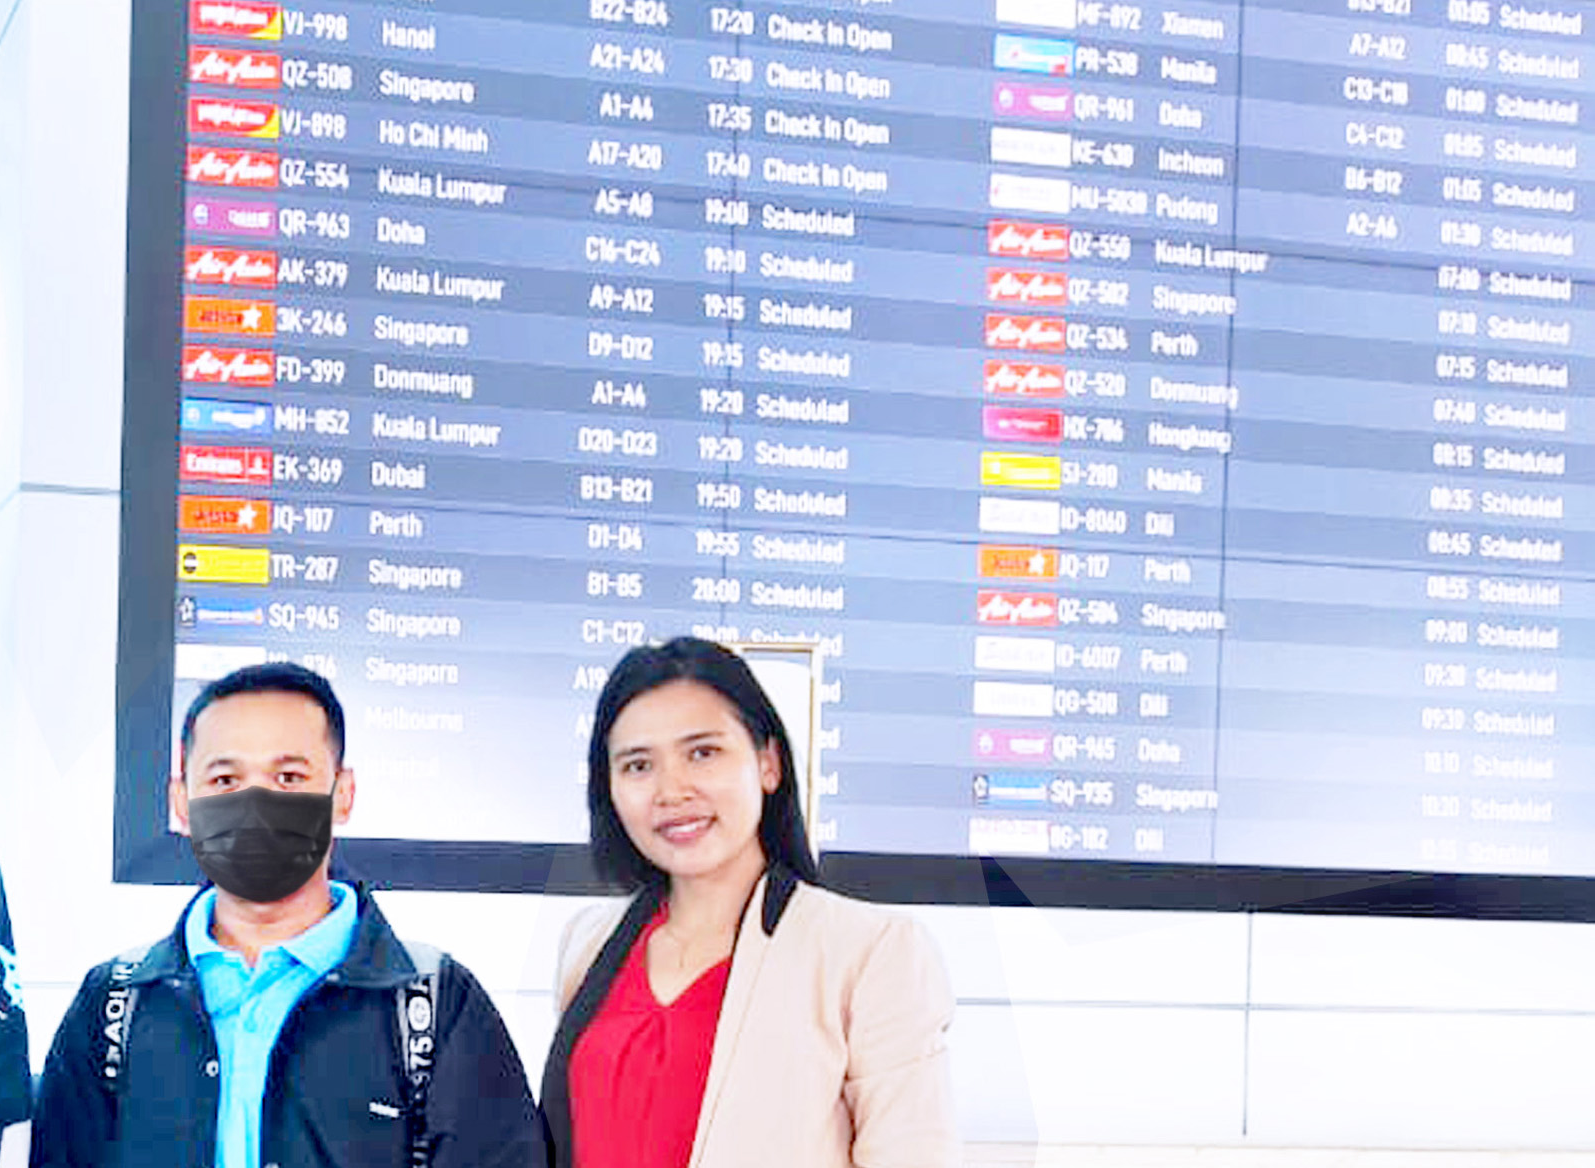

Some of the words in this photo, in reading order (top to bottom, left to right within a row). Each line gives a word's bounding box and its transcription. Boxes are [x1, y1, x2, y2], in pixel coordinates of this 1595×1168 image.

[284, 12, 347, 40] VJ-998
[382, 20, 435, 49] Hanoi
[590, 44, 665, 74] A21-A24
[709, 56, 753, 83] 17:30
[767, 62, 822, 90] Check
[826, 70, 842, 92] In
[846, 71, 890, 98] Open
[711, 9, 754, 35] 17:20
[768, 15, 823, 43] Check
[828, 22, 844, 45] In
[847, 24, 892, 51] Open
[1161, 56, 1217, 84] Manila
[379, 70, 474, 102] Singapore
[600, 93, 653, 120] A1-A4
[708, 104, 752, 131] 17:35
[765, 110, 820, 138] Check
[825, 117, 841, 139] In
[844, 119, 889, 146] Open
[380, 120, 405, 144] Ho
[409, 122, 439, 147] Chi
[443, 125, 488, 152] Minh
[589, 141, 662, 171] A17-A20
[764, 158, 819, 185] Check
[822, 165, 839, 188] In
[842, 166, 887, 191] Open
[280, 160, 348, 189] QZ-554
[379, 169, 431, 196] Kuala
[436, 175, 506, 205] Lumpur
[763, 205, 854, 236] Scheduled
[1156, 193, 1218, 224] Pudong
[279, 209, 350, 237] QR-963
[377, 218, 425, 245] Doha
[761, 252, 853, 283] Scheduled
[1156, 240, 1202, 266] Kuala
[1205, 245, 1269, 273] Lumpur
[277, 259, 347, 287] AK-379
[377, 266, 429, 294] Kuala
[433, 271, 504, 301] Lumpur
[759, 299, 851, 329] Scheduled
[1153, 286, 1237, 315] Singapore
[375, 316, 469, 347] Singapore
[759, 347, 850, 377] Scheduled
[1151, 331, 1198, 356] Perth
[277, 357, 345, 383] FD-399
[375, 364, 472, 398] Donmuang
[592, 381, 646, 407] A1-A4
[757, 395, 848, 423] Scheduled
[373, 413, 426, 440] Kuala
[430, 418, 501, 446] Lumpur
[756, 441, 848, 470] Scheduled
[274, 455, 343, 484] EK-369
[372, 462, 425, 489] Dubai
[755, 488, 846, 516] Scheduled
[370, 510, 423, 537] Perth
[753, 536, 844, 563] Scheduled
[369, 560, 462, 589] Singapore
[752, 582, 844, 610] Scheduled
[269, 603, 340, 632] SQ-945
[367, 608, 460, 638] Singapore
[1142, 604, 1227, 631] Singapore
[366, 656, 458, 685] Singapore
